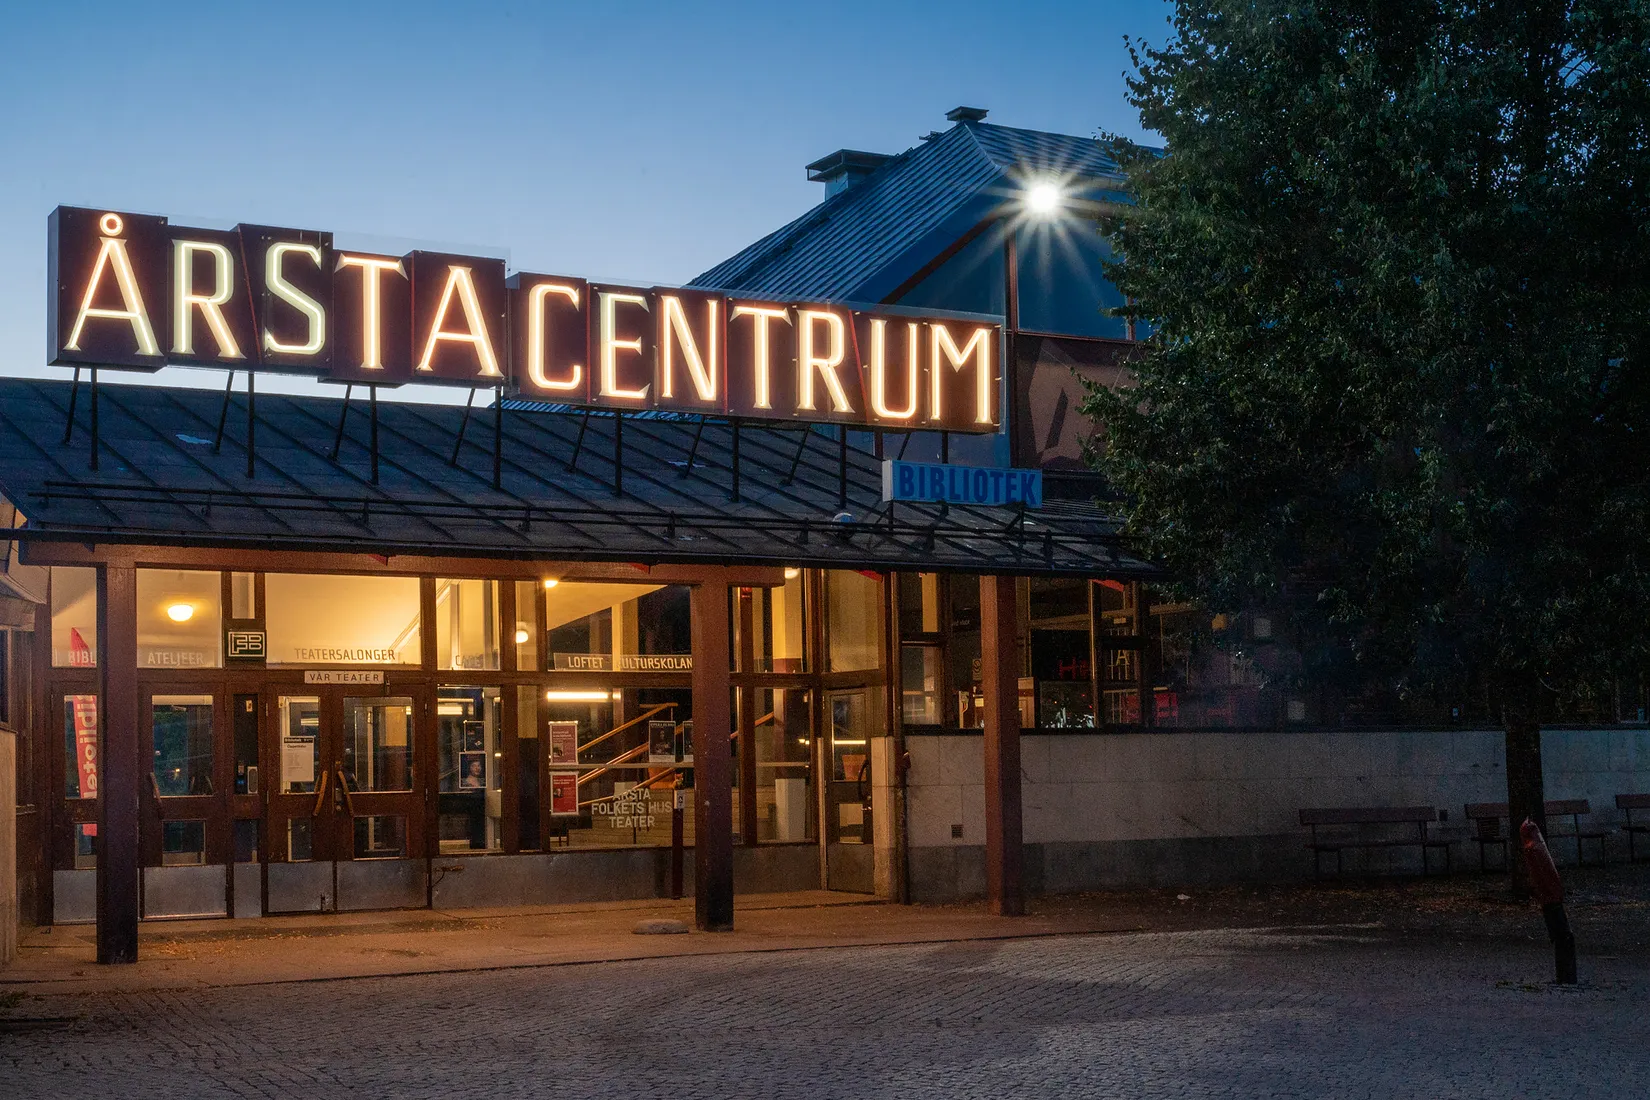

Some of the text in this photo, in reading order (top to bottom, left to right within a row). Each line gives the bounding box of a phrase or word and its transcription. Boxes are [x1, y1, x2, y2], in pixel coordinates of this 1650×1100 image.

[64, 213, 994, 424] ÅRSTA CENTRUM
[898, 462, 1038, 503] BIBLIOTEK
[147, 652, 204, 666] ATELJEER
[295, 647, 396, 661] TEATERSALONGER
[567, 655, 693, 670] LOFTET ULTURSKOLAN
[336, 673, 380, 682] TEATER
[591, 802, 645, 816] FOLKETS
[648, 801, 674, 814] HUS
[608, 815, 656, 829] TEATER
